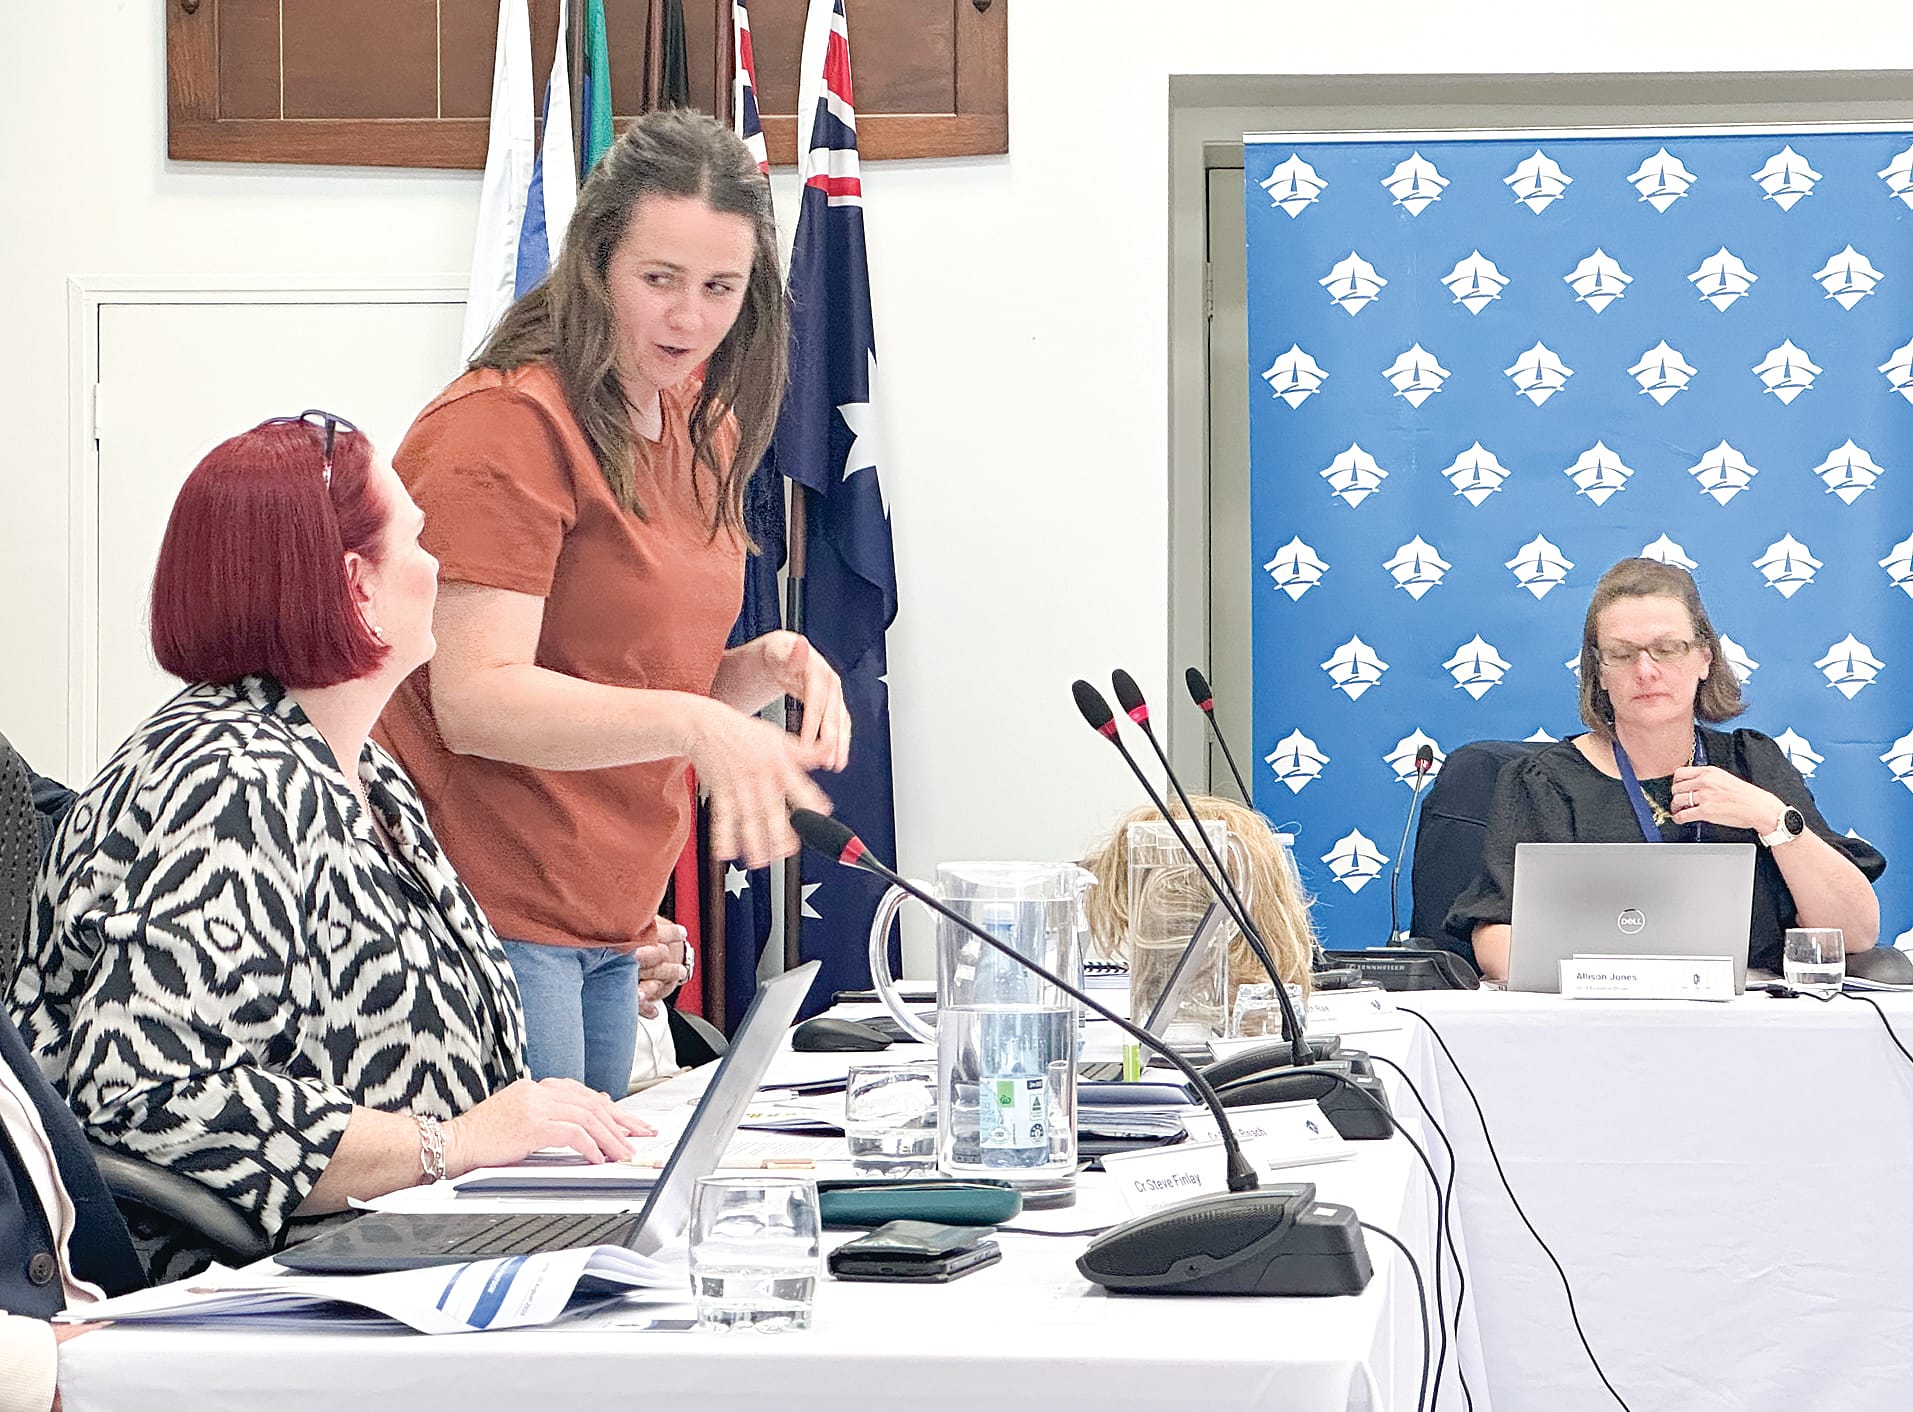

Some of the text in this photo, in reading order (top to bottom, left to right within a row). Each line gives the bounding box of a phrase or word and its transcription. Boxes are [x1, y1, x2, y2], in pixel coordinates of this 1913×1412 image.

[1620, 917, 1642, 926] DELL
[1576, 972, 1637, 982] Allison Jones
[1134, 1172, 1202, 1193] Cr Steve Finlay
